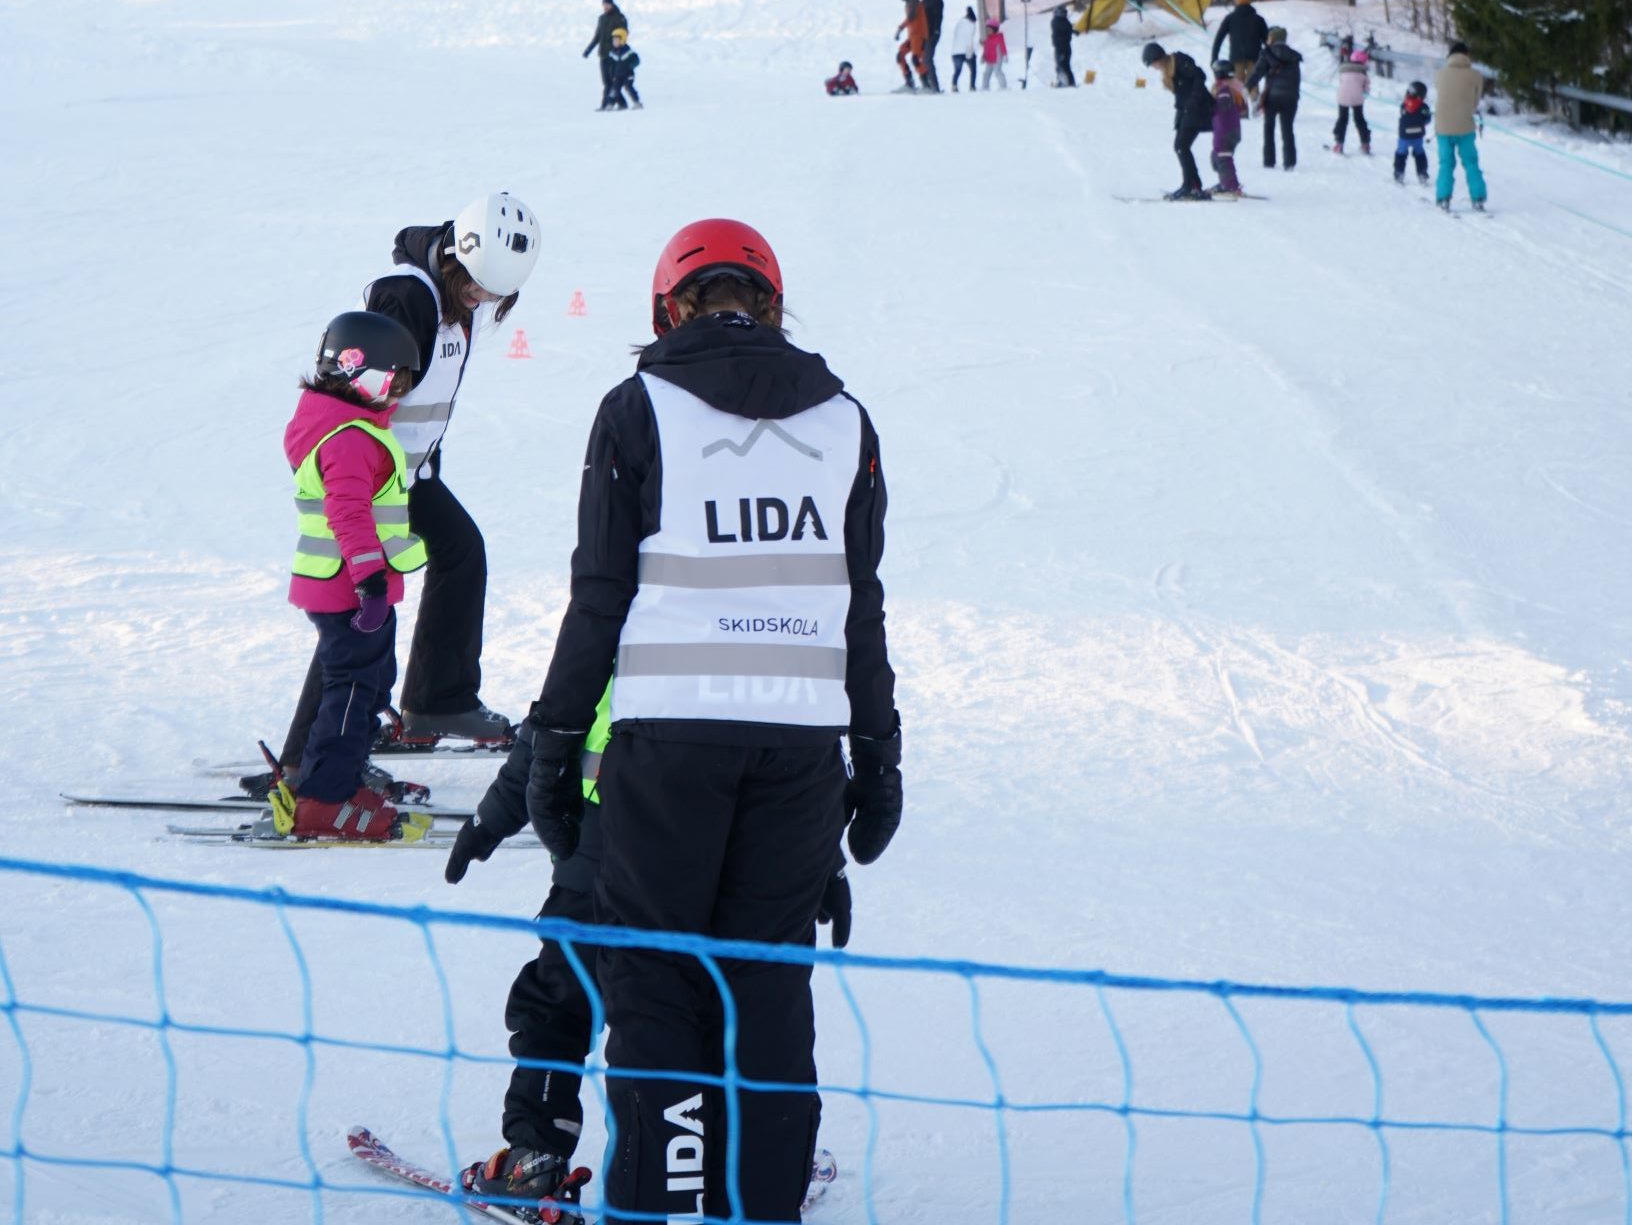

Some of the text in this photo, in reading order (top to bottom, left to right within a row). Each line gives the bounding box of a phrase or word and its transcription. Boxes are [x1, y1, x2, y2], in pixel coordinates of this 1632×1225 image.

[440, 341, 461, 359] IDA
[704, 496, 829, 544] LIDA
[718, 617, 819, 637] SKIDSKOLA
[664, 1093, 705, 1225] LIDA
